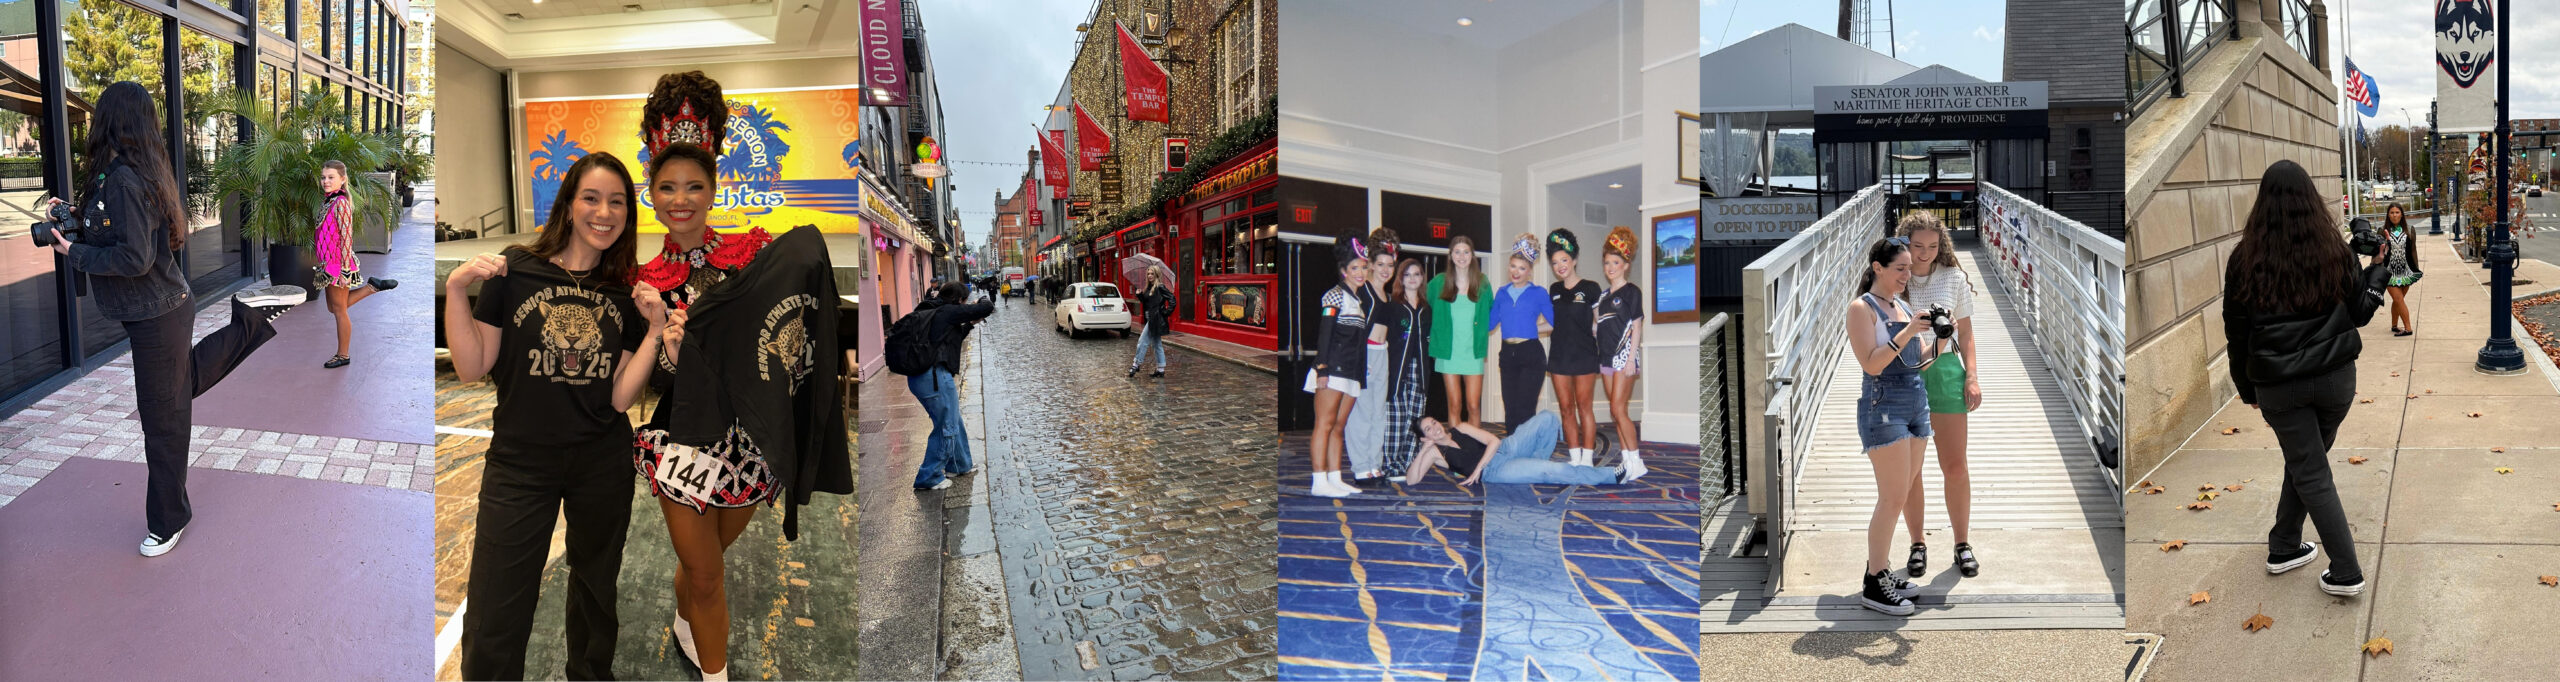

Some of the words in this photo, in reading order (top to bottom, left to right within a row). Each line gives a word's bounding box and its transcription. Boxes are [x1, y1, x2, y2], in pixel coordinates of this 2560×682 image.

[869, 19, 897, 84] CLOUD
[1142, 86, 1157, 94] THE
[1850, 87, 1910, 99] SENATOR
[1915, 87, 1949, 98] JOHN
[1953, 85, 2010, 97] WARNER
[1132, 92, 1167, 104] TEMPLE
[1142, 101, 1160, 110] BAR
[1833, 99, 1901, 111] MARITIME
[1906, 98, 1972, 109] HERITAGE
[1975, 96, 2028, 108] CENTER
[1856, 114, 1873, 125] home
[1874, 115, 1893, 127] port
[1893, 113, 1902, 127] of
[1904, 113, 1919, 124] tall
[1920, 113, 1936, 127] ship
[1940, 113, 2007, 124] PROVIDENCE
[726, 115, 767, 166] REGION
[1195, 181, 1216, 200] THE
[1217, 158, 1269, 192] TEMPLE
[1295, 208, 1312, 224] EXIT
[1719, 203, 1793, 215] DOCKSIDE
[1795, 203, 1818, 215] BA
[1433, 225, 1447, 239] EXIT
[1713, 221, 1752, 233] OPEN
[1755, 221, 1776, 232] TO
[513, 287, 554, 328] SENIOR
[556, 286, 604, 304] ATHLETE
[757, 328, 771, 382] SENIOR
[765, 294, 803, 331] ATHLETE
[528, 349, 556, 376] 20
[585, 352, 612, 379] 25
[667, 455, 710, 494] 144
